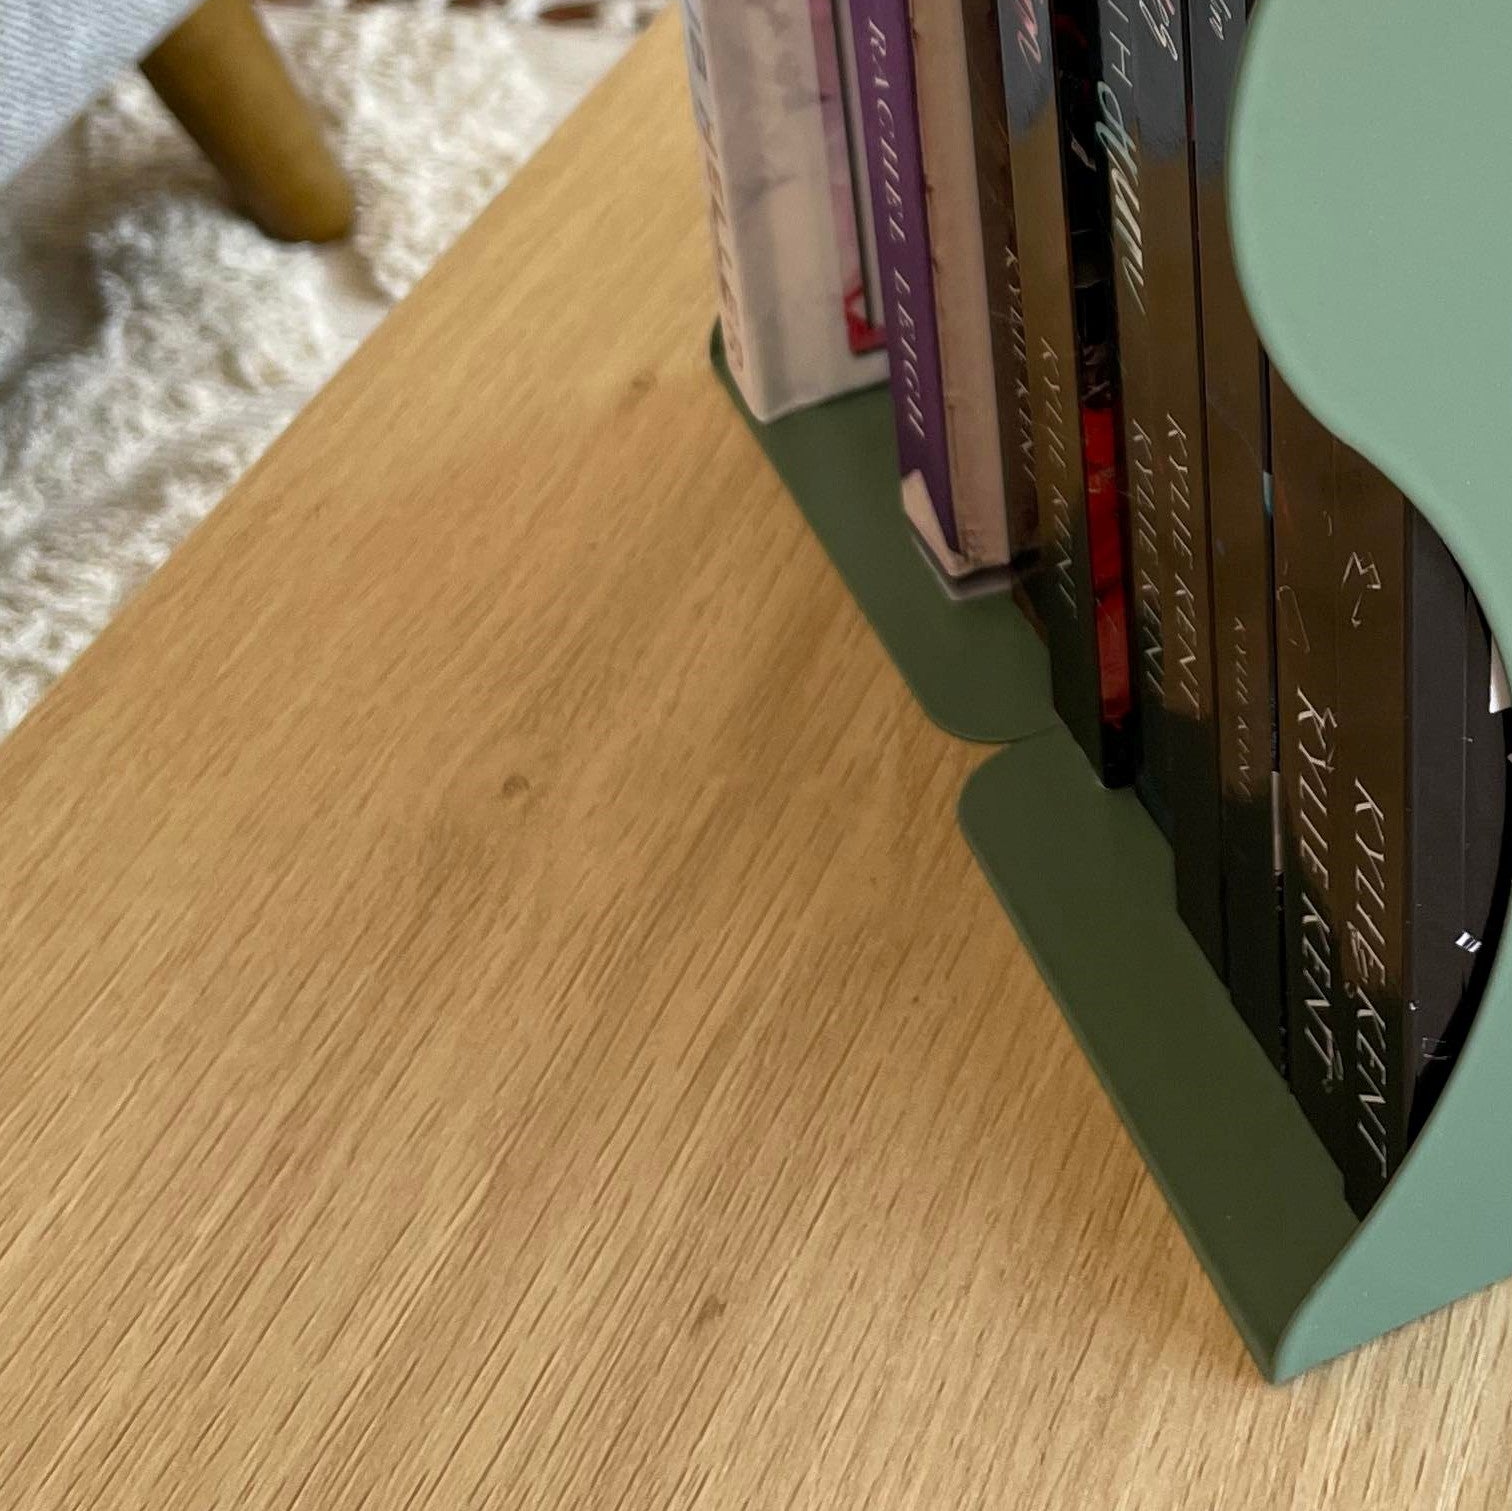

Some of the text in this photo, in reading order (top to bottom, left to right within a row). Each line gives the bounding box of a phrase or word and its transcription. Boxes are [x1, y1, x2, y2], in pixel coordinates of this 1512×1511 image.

[867, 15, 926, 441] RACHEL LEIGH
[1040, 336, 1077, 621] KYLIE KENT
[1132, 419, 1167, 711] KYLIE KENT
[1165, 412, 1200, 721] KYLIE KENT
[1296, 687, 1332, 1082] KYLIE KENT
[1354, 775, 1388, 1181] KYLIE KENT
